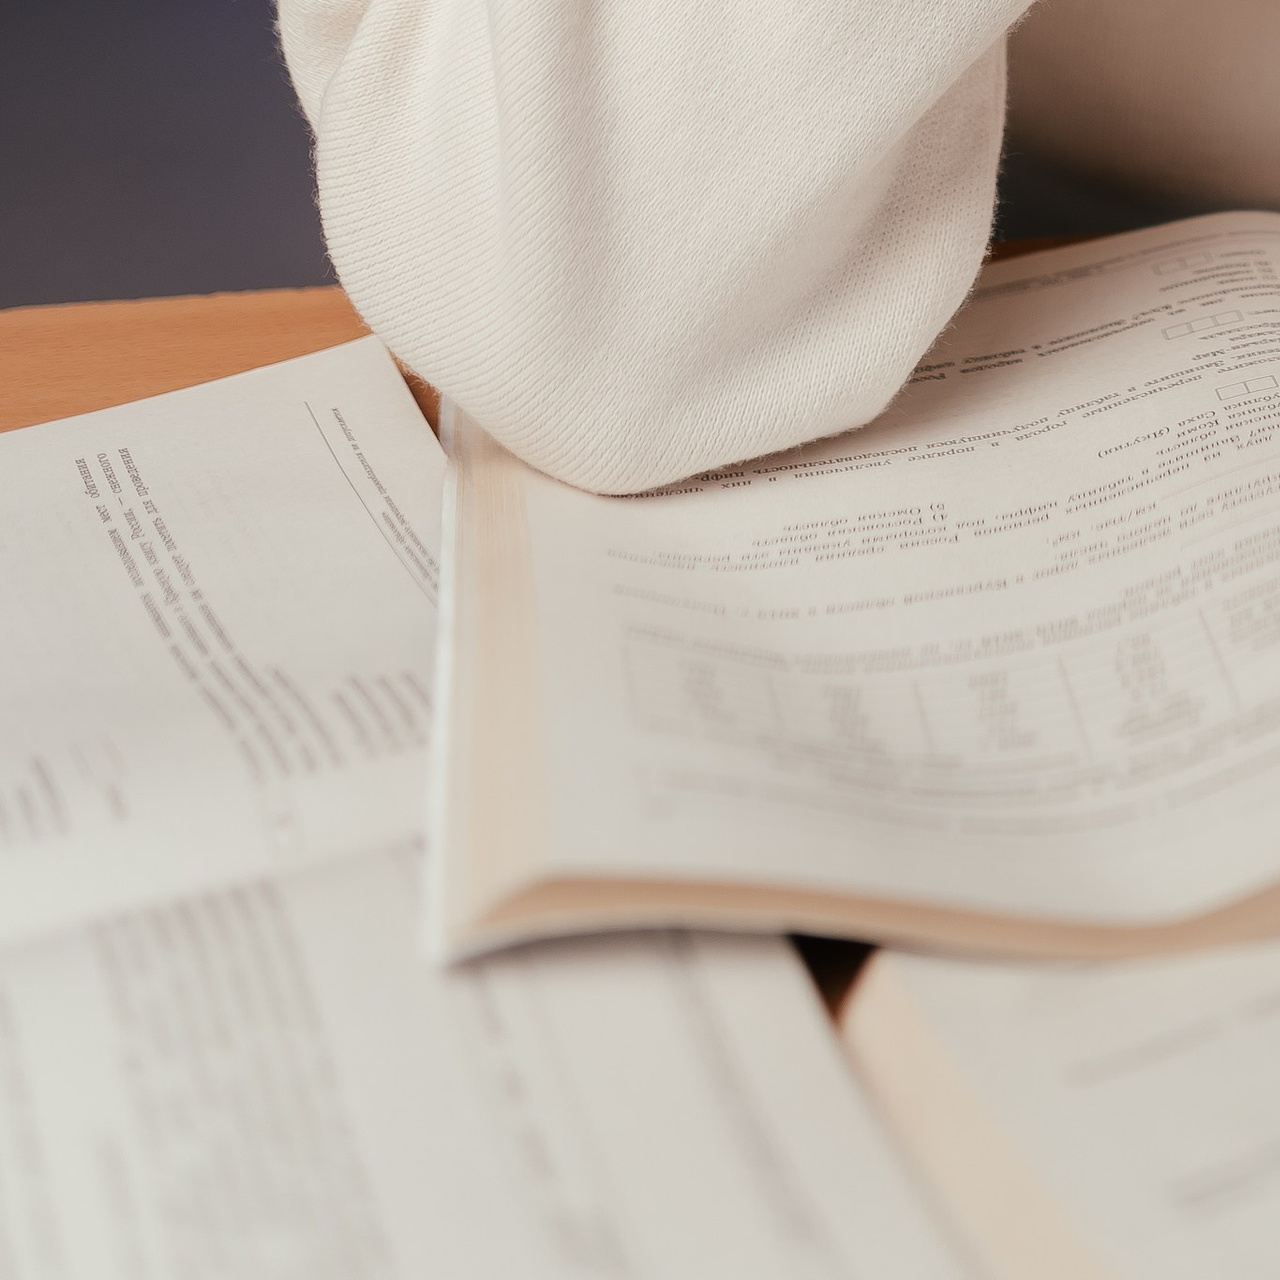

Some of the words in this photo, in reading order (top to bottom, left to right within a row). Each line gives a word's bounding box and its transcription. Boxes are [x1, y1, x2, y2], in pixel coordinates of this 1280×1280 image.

[1143, 359, 1224, 387] Запишите
[1056, 392, 1121, 417] таблицу
[1082, 375, 1202, 419] перечисленные
[1176, 418, 1219, 438] Коми
[1177, 410, 1216, 428] Саха
[926, 417, 1050, 450] получившуюся
[1015, 420, 1068, 442] города
[1097, 426, 1170, 459] (Якутия)
[1155, 430, 1217, 455] область
[1158, 435, 1240, 468] Запишите
[1235, 434, 1271, 451] двух
[752, 445, 918, 476] последовательность
[906, 445, 976, 463] порядке
[1203, 451, 1221, 461] из
[75, 457, 100, 499] обитания
[96, 451, 123, 494] снежного
[117, 447, 149, 498] проведения
[794, 459, 891, 480] увеличения
[721, 480, 752, 490] них
[1064, 463, 1190, 515] перечисленных
[1067, 476, 1133, 502] таблицу
[142, 498, 158, 515] для
[857, 507, 921, 521] Омская
[782, 519, 848, 532] область
[827, 517, 923, 536] Ростовская
[932, 513, 948, 521] 4)
[956, 518, 984, 528] под
[974, 513, 1049, 537] регионов
[752, 533, 818, 547] область
[861, 525, 947, 544] которыми
[900, 534, 959, 550] России
[779, 539, 850, 556] указаны
[815, 545, 884, 562] средняя
